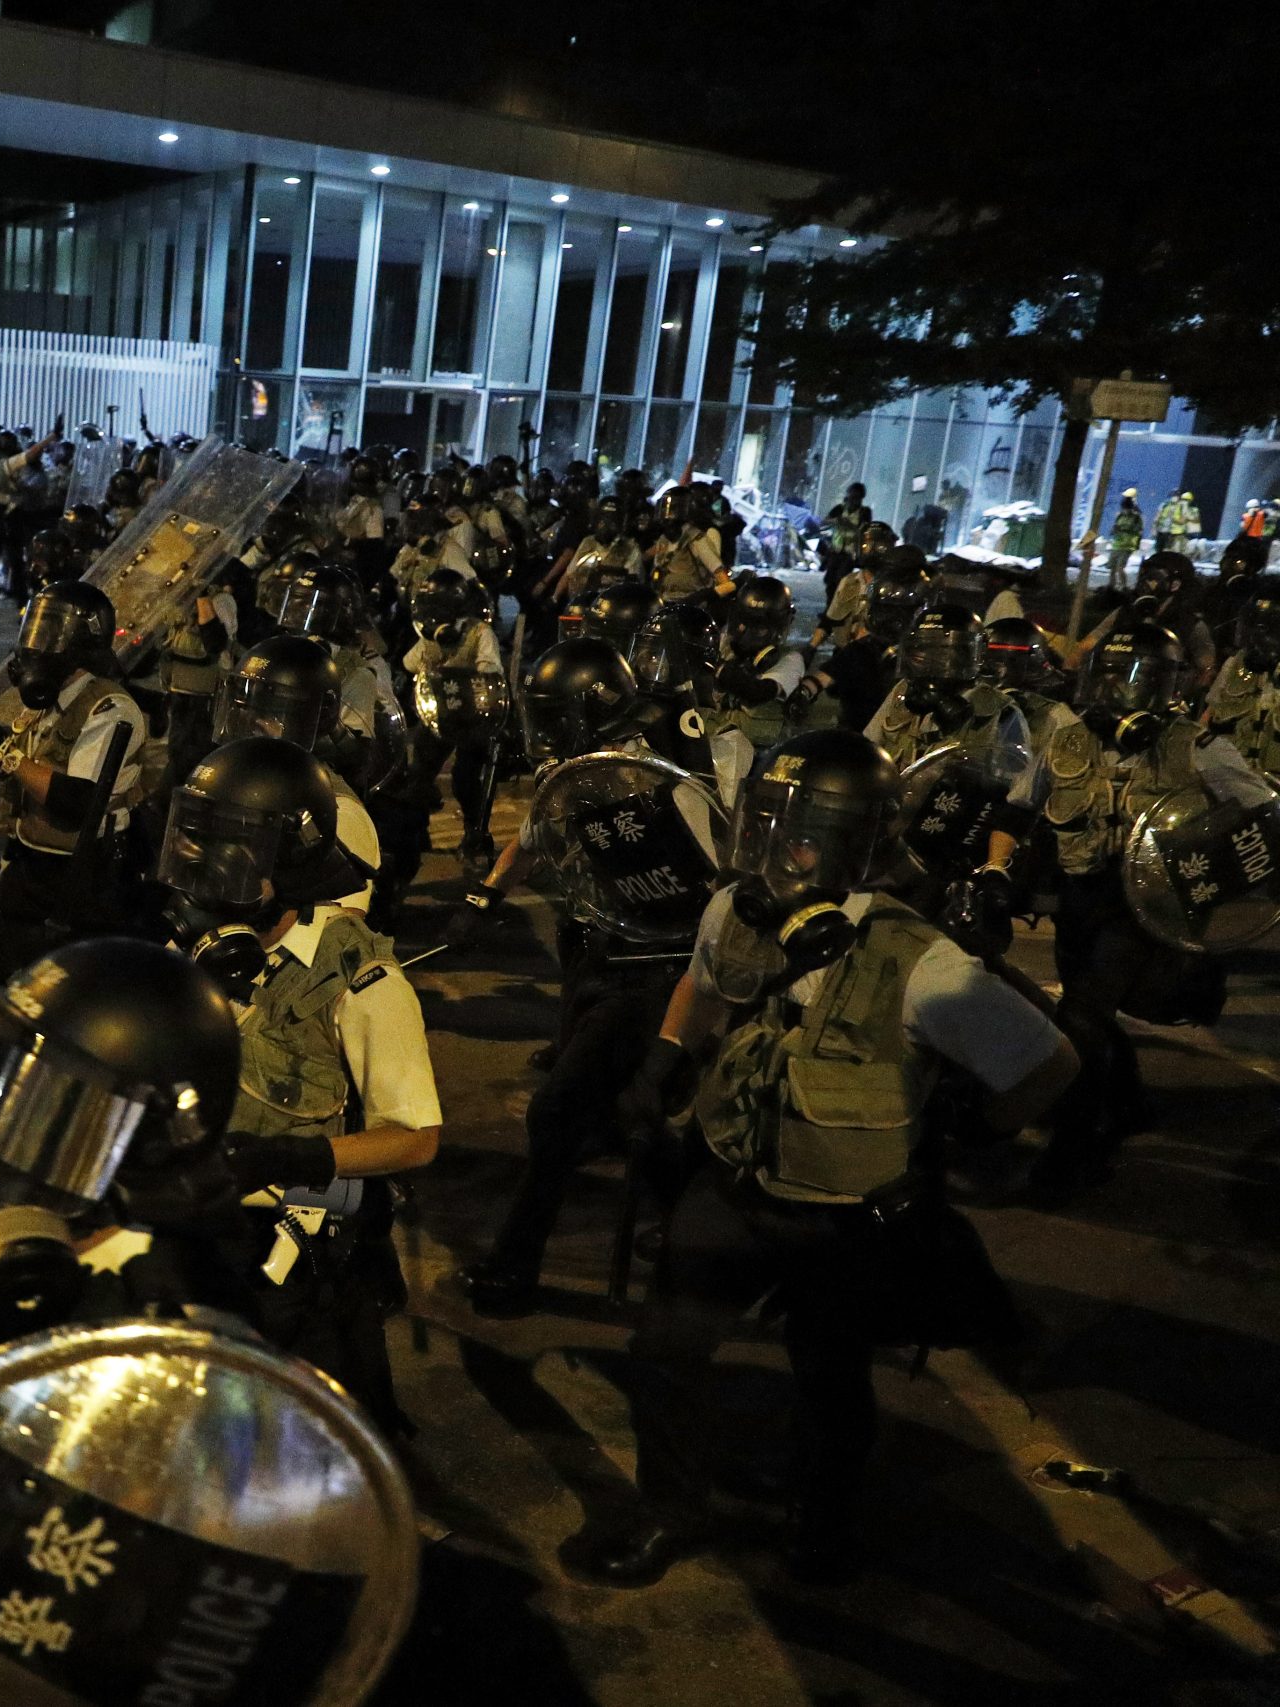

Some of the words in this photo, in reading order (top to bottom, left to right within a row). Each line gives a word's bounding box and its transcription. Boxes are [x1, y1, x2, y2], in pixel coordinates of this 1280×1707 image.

[584, 810, 646, 851] 警察
[1231, 821, 1275, 884] POLICE
[615, 865, 689, 904] POLICE
[1177, 851, 1219, 905] 警察
